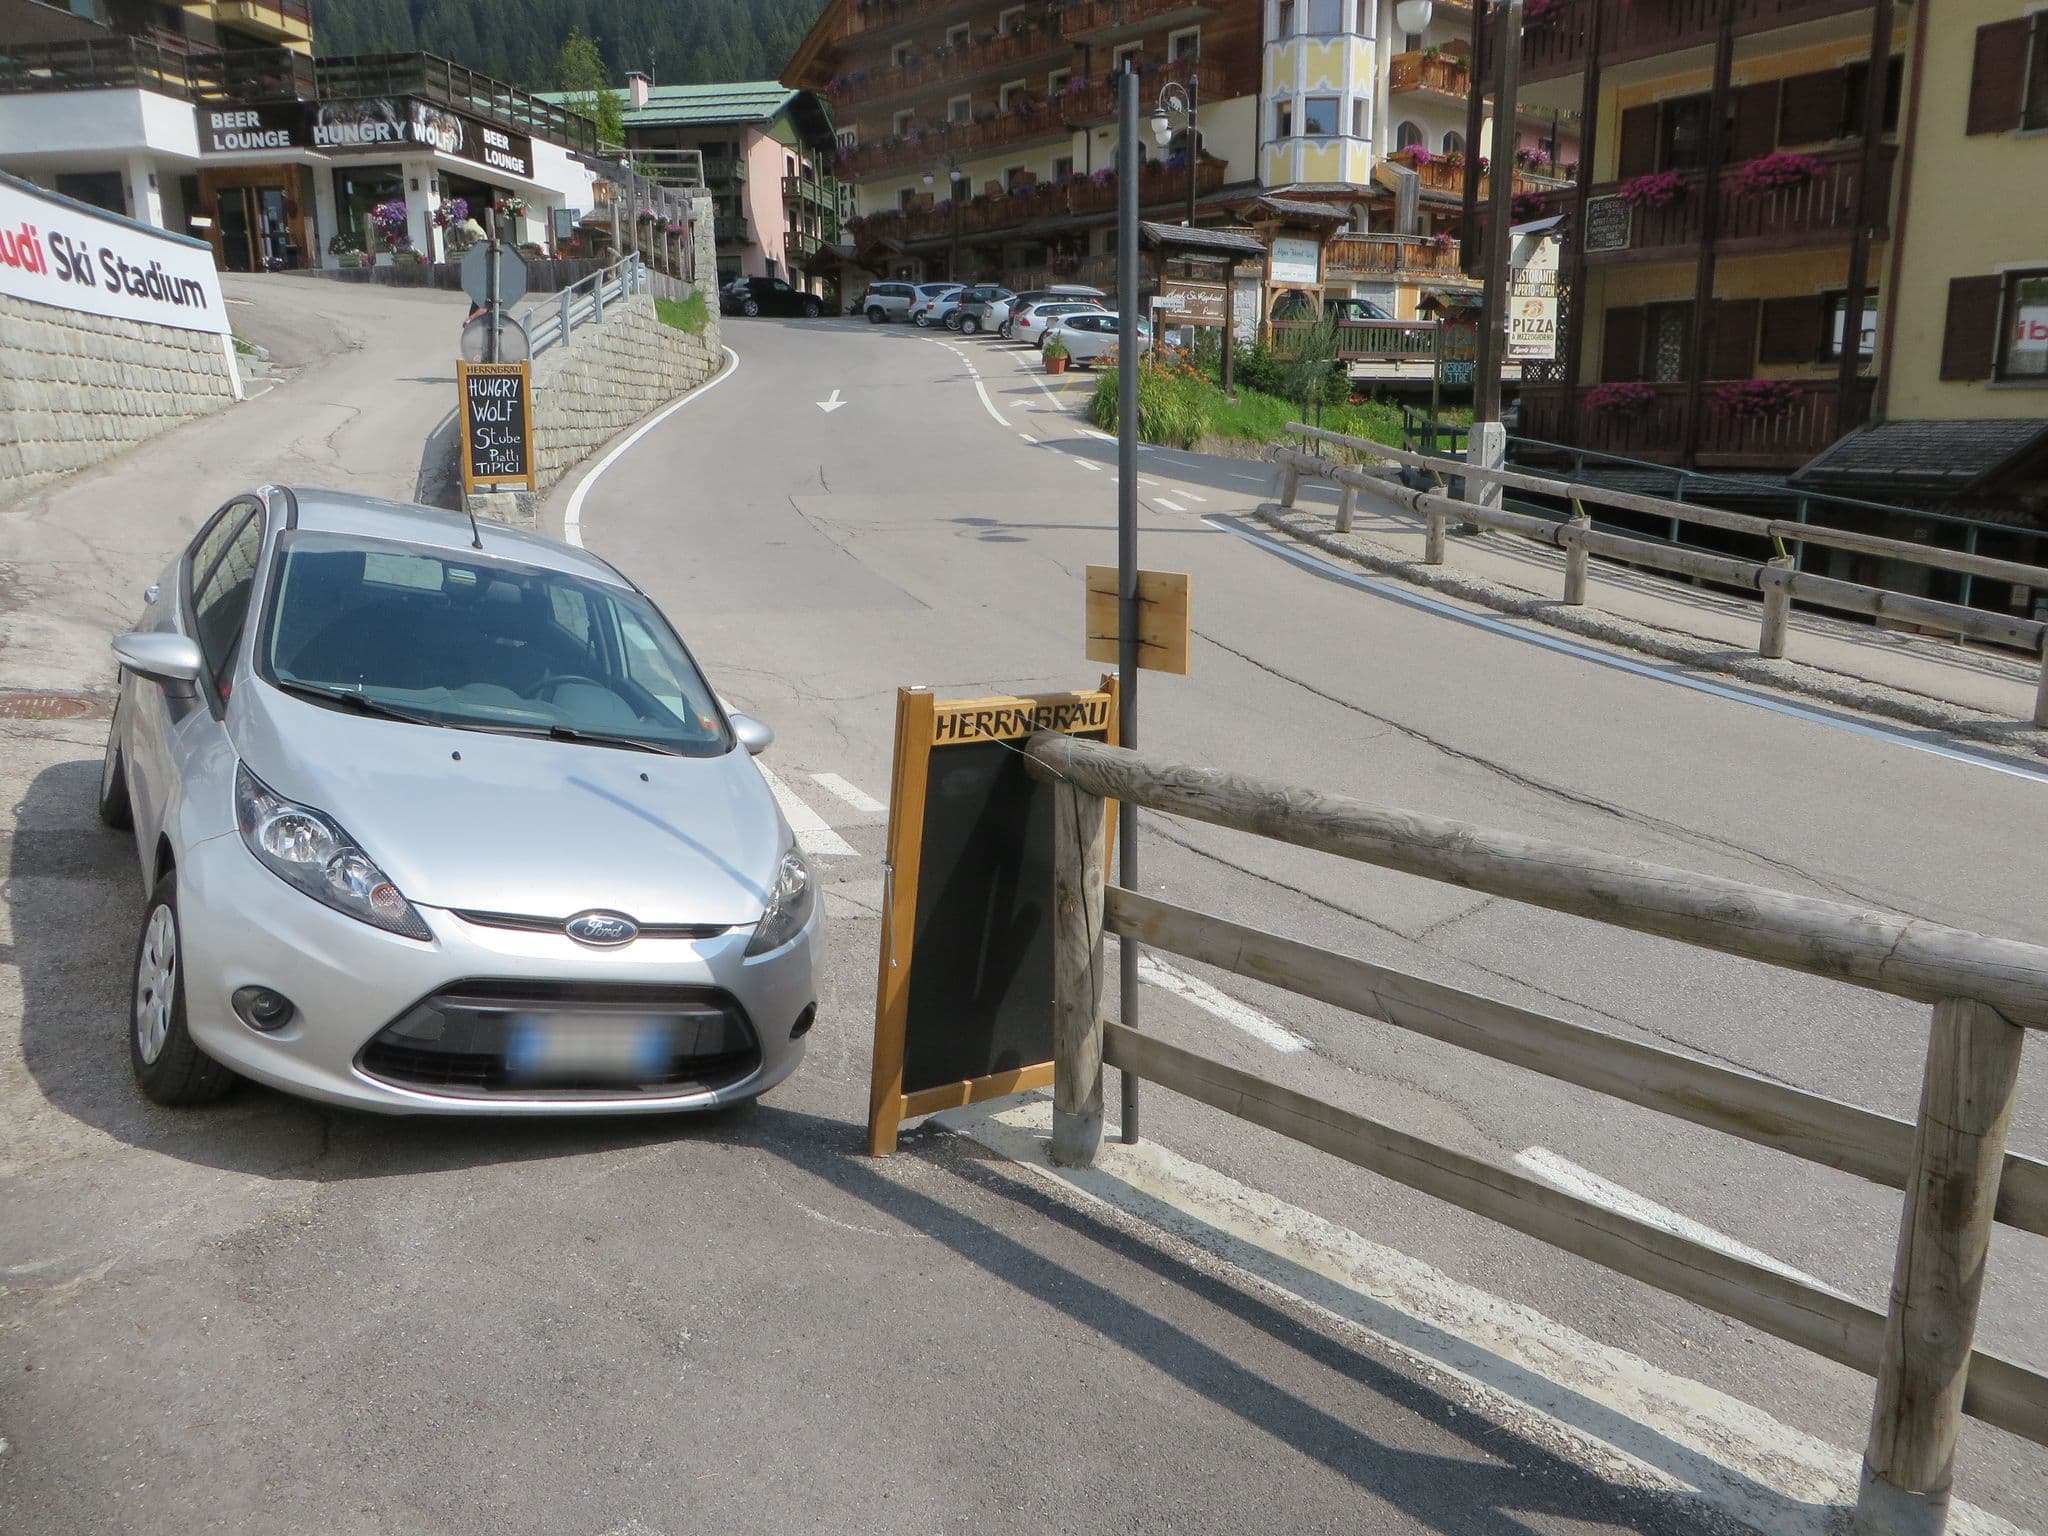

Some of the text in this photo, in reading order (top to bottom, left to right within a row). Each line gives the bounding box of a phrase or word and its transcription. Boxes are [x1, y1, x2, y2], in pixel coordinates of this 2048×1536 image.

[211, 111, 260, 128] BEER
[213, 130, 290, 150] LOUNGE
[313, 121, 453, 152] HUNGRY WOLF
[483, 128, 510, 150] BEER
[485, 148, 525, 174] LOUNGE
[0, 222, 208, 310] udi Ski Stadium
[1515, 269, 1556, 284] RISTORANTE
[1514, 284, 1535, 296] APERTO
[1540, 284, 1555, 296] OPEN
[1512, 319, 1554, 333] PIZZA
[469, 379, 519, 397] HUNGRY
[475, 427, 520, 449] Stube
[476, 462, 519, 474] TIPICI
[935, 701, 1108, 741] HERRNBRÄU
[584, 918, 622, 938] Ford
